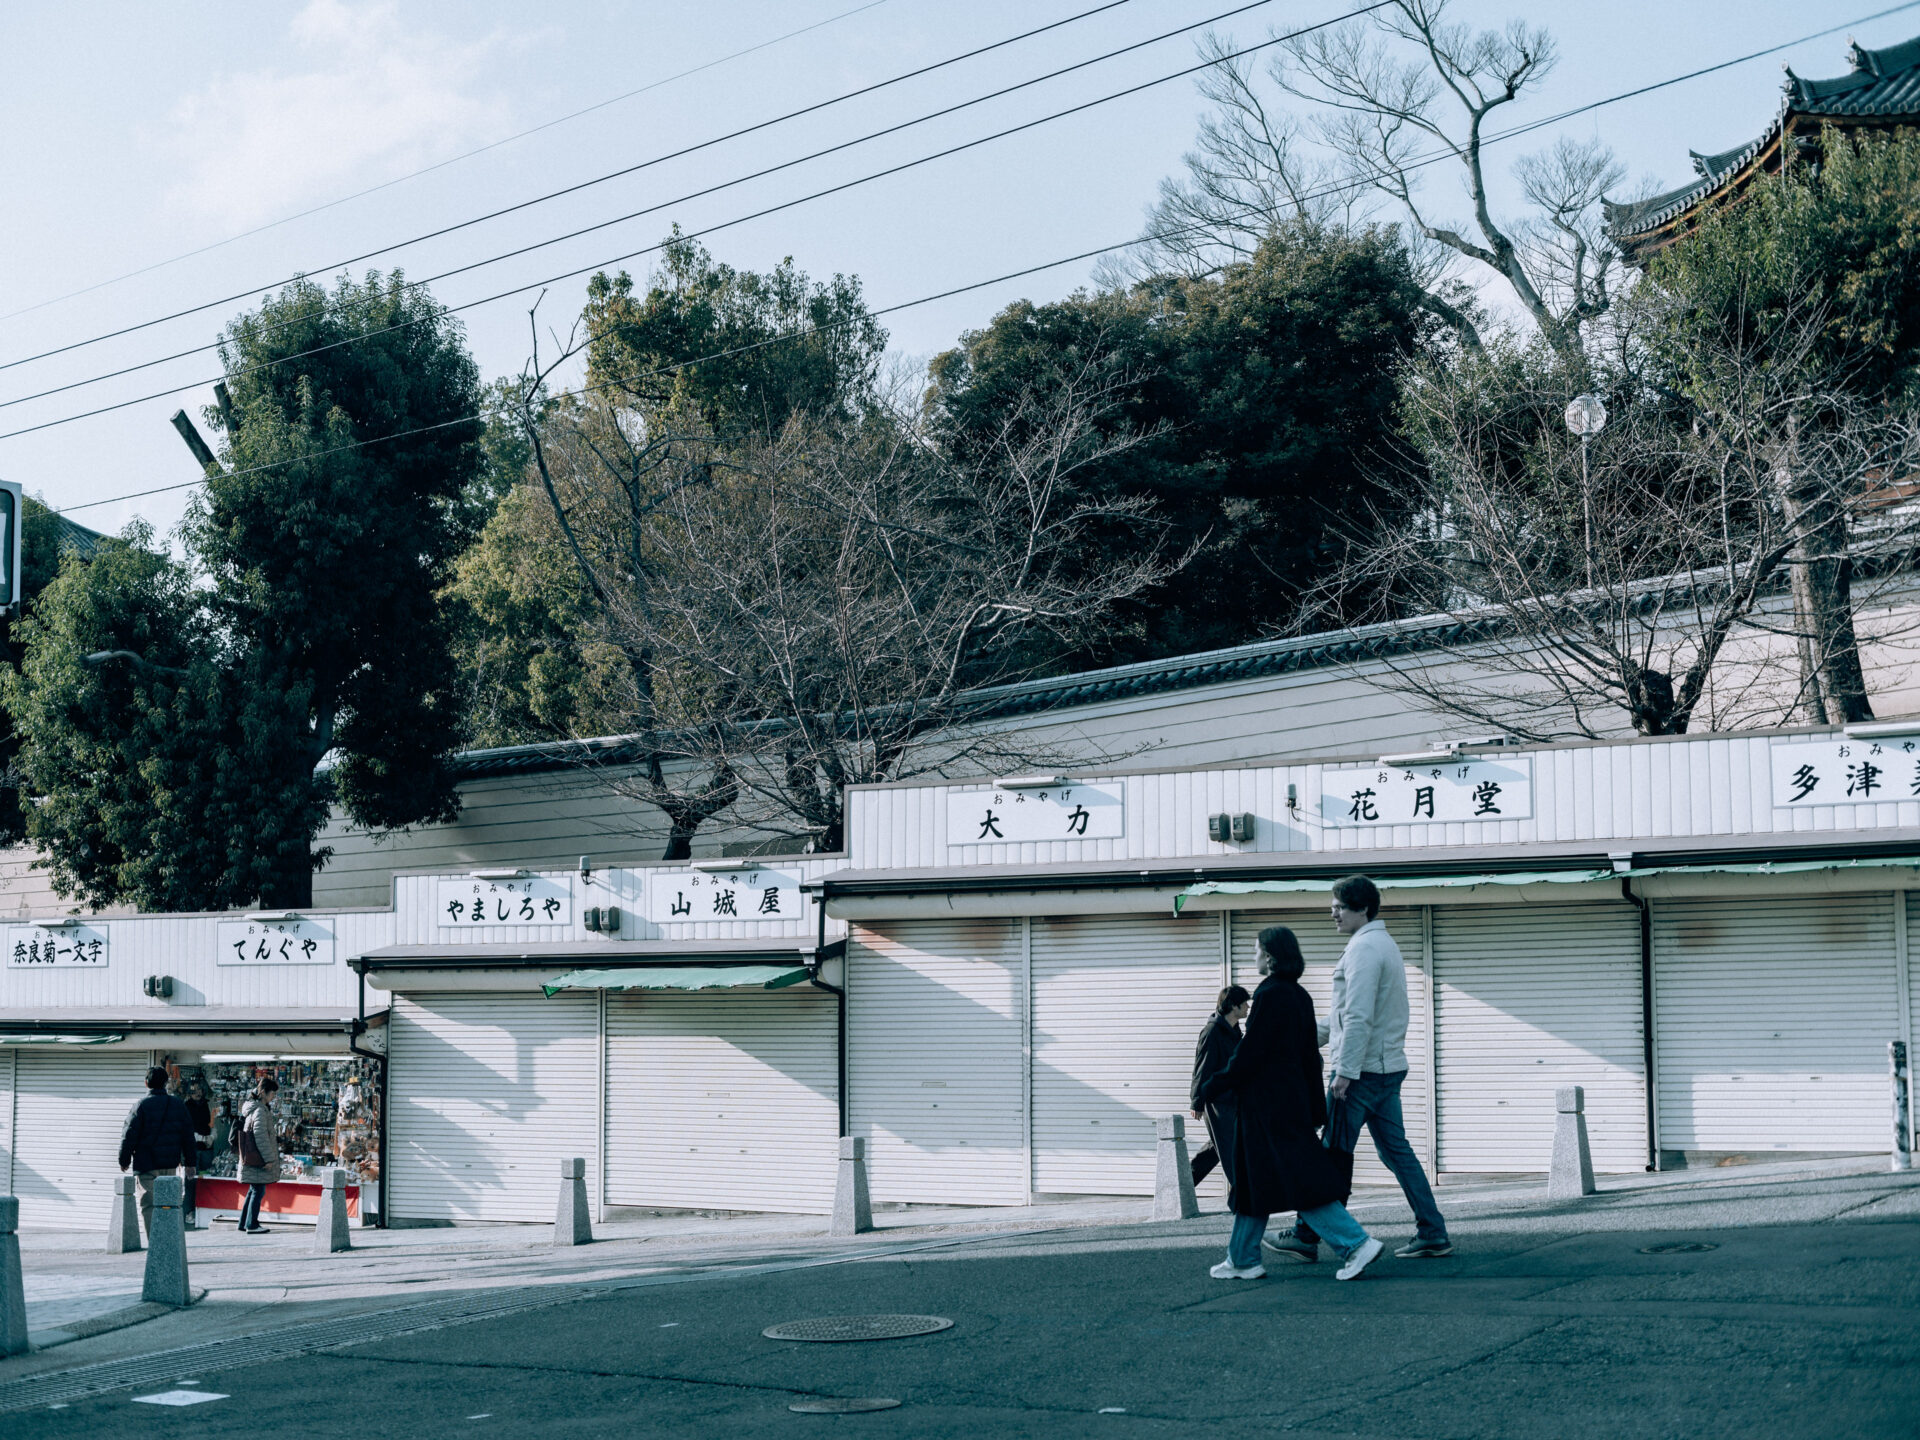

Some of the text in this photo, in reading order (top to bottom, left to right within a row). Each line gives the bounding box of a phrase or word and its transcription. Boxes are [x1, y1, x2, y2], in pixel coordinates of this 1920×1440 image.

[1377, 764, 1470, 783] おみやげ
[993, 788, 1072, 805] おみやげ
[1348, 780, 1502, 822] 花月堂
[977, 804, 1090, 840] 大力
[472, 881, 533, 894] おみやげ
[690, 872, 759, 887] おみやげ
[446, 896, 561, 922] やましろや
[671, 886, 781, 917] 山城屋
[34, 929, 81, 940] おみやげ
[247, 923, 302, 935] おみやげ
[13, 938, 103, 965] 奈良菊一文字
[232, 937, 318, 962] てんぐや
